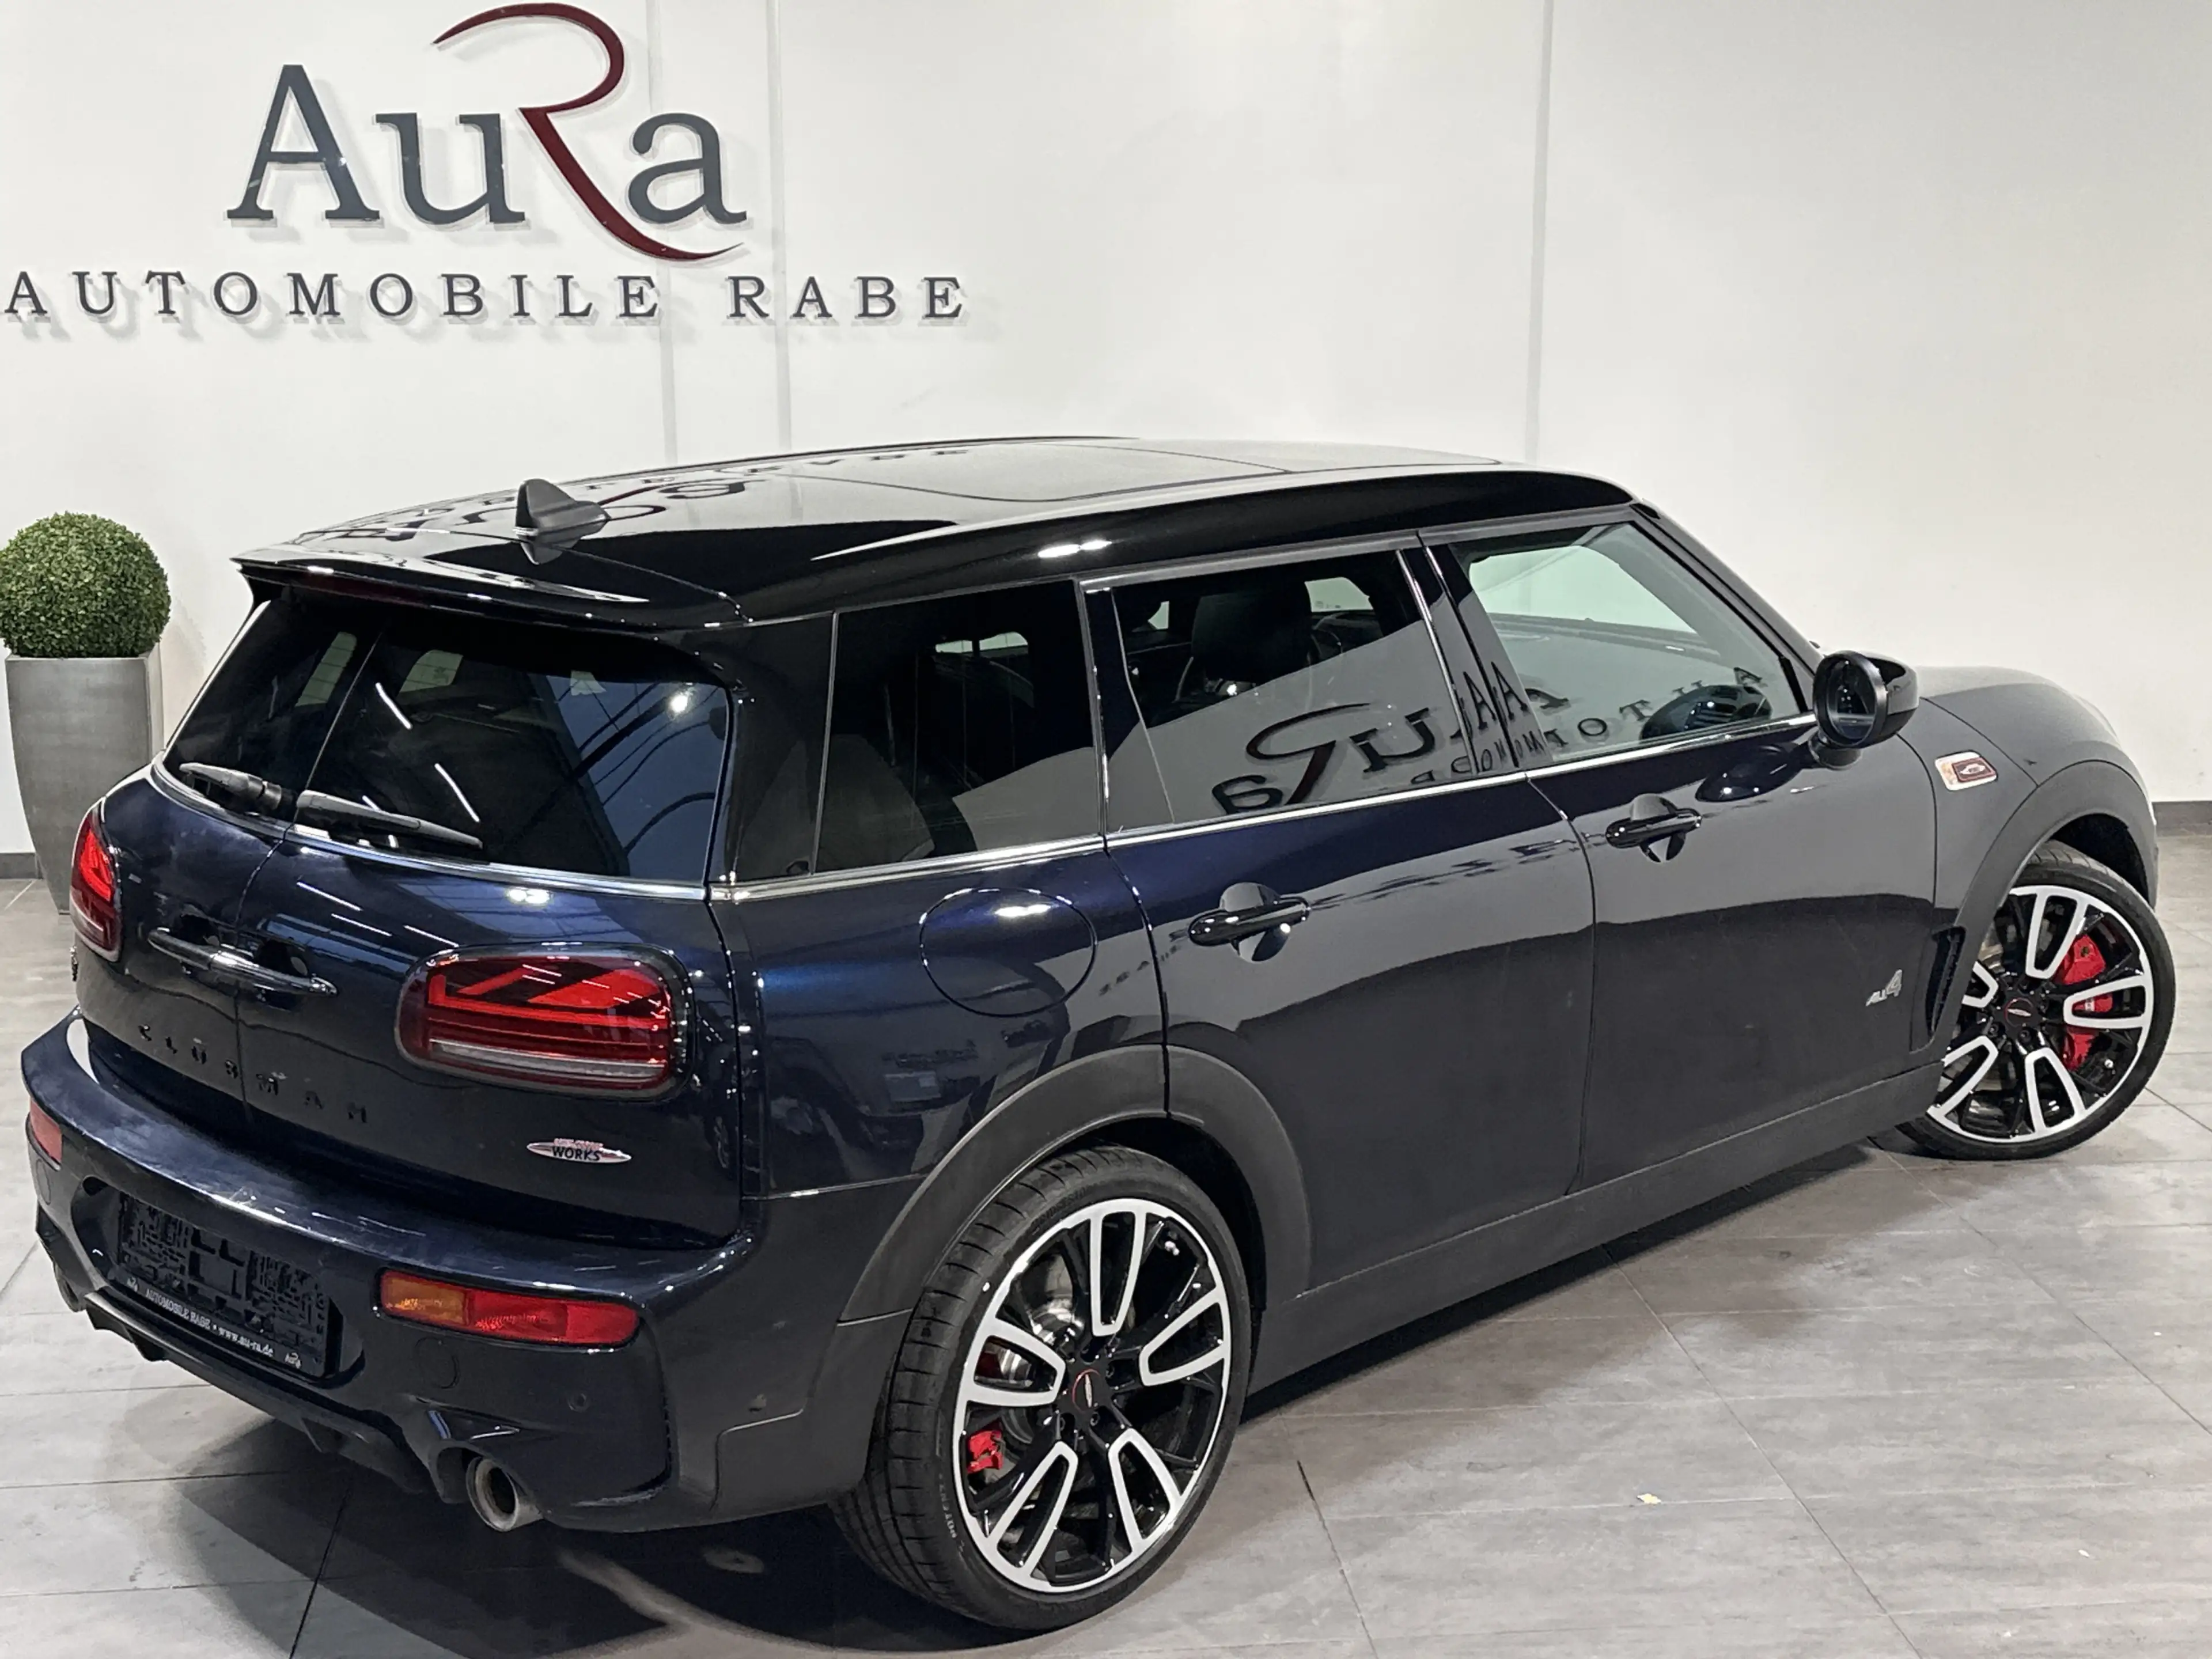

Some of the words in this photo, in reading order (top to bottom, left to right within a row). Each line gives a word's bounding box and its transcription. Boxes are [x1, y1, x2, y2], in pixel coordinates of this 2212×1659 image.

[228, 2, 747, 262] AuRa
[5, 271, 658, 318] AUTOMOBILE
[727, 275, 963, 318] RABE
[551, 1146, 603, 1161] WORKS
